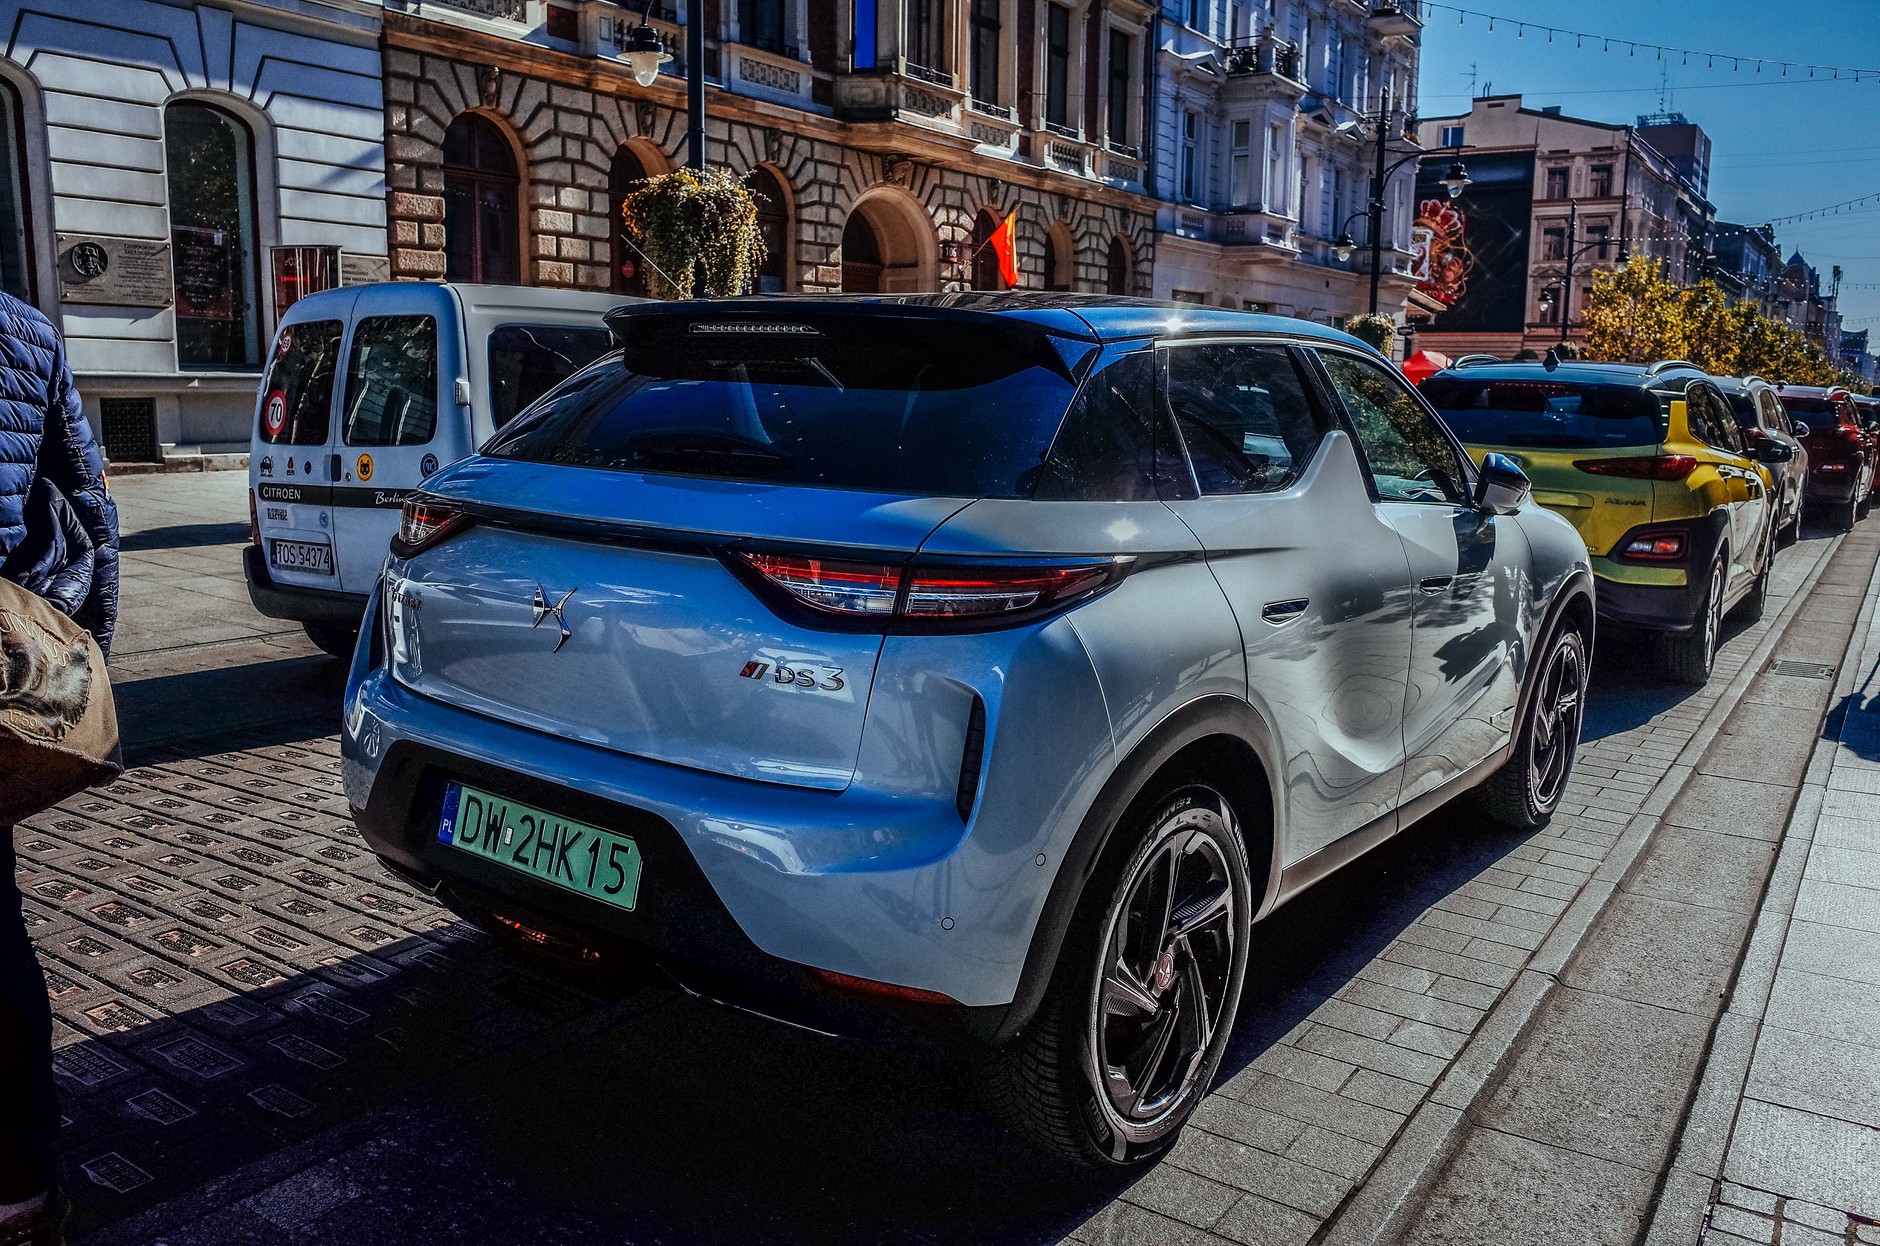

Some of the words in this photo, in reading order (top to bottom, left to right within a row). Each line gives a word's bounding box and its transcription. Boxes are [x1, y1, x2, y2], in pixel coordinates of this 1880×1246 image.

[945, 247, 957, 257] 106
[270, 403, 283, 423] 70
[263, 486, 300, 500] CITROËN
[375, 491, 405, 505] Berlin
[277, 543, 296, 564] TOS
[298, 545, 330, 569] 54374
[442, 818, 453, 834] PL
[459, 794, 507, 854] DW
